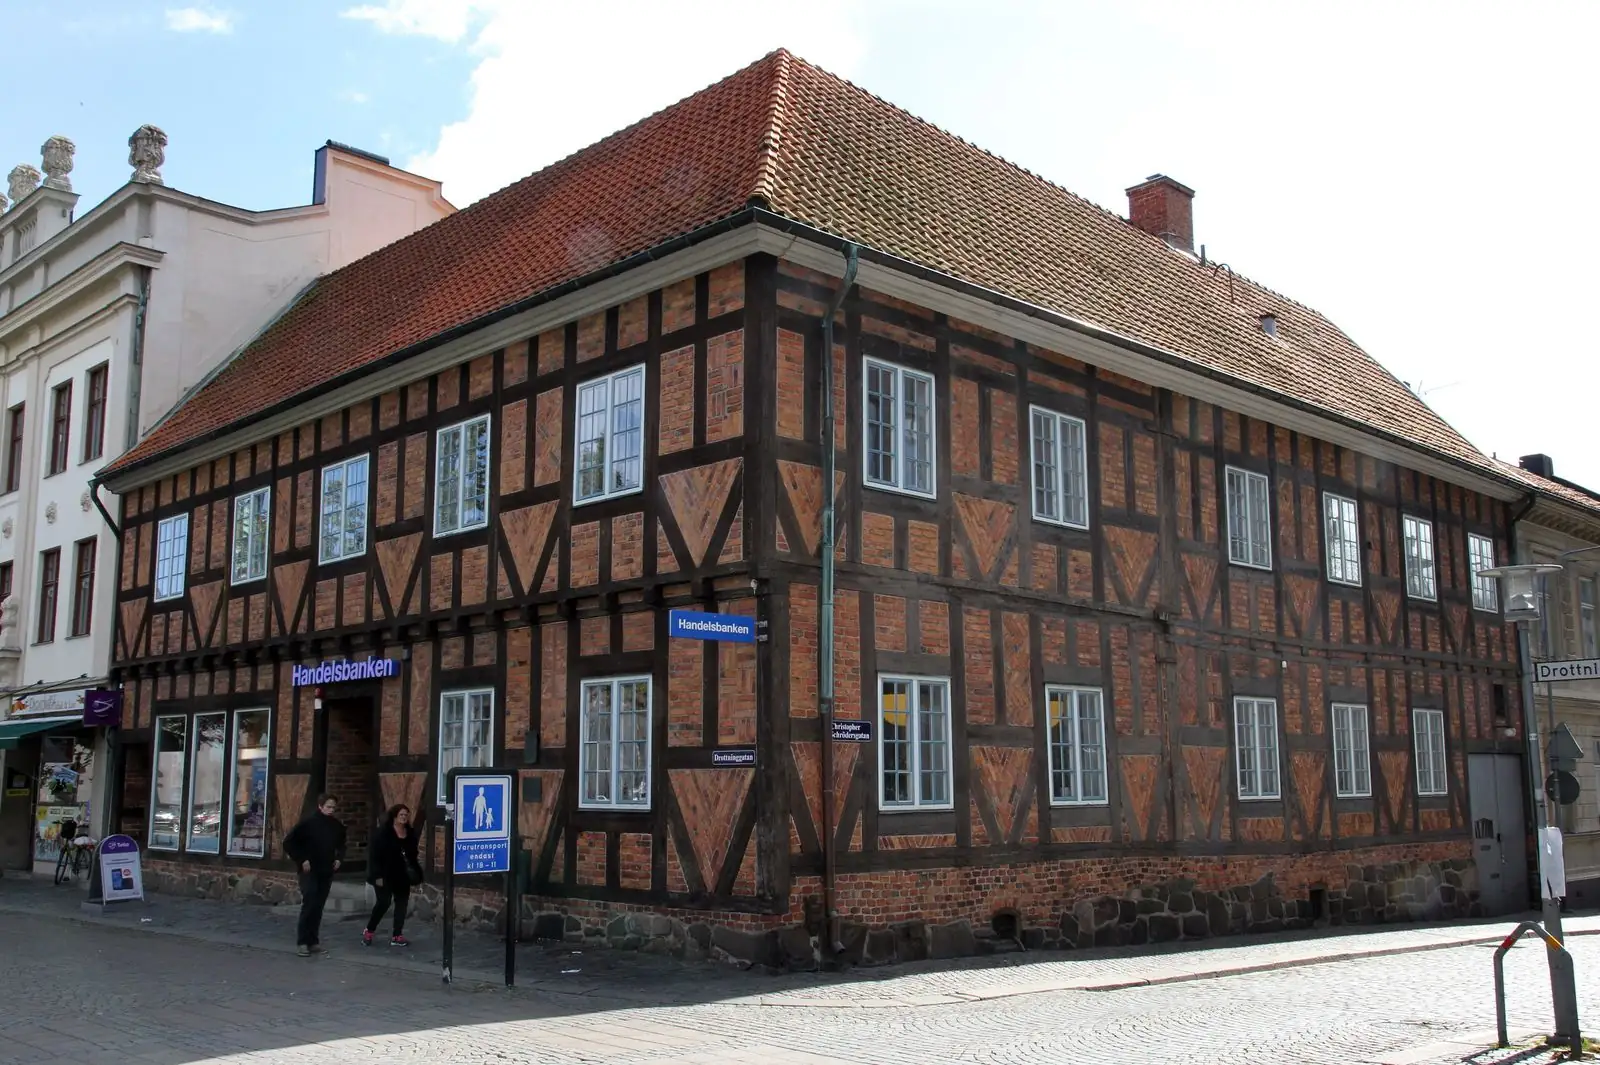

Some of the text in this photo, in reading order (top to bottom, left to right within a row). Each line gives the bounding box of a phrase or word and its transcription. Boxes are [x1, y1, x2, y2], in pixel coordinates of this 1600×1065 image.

[678, 618, 749, 635] Handelsbanken
[292, 655, 393, 687] Handelsbanken
[1540, 662, 1598, 678] Drottni
[457, 843, 507, 851] Varutransport
[470, 852, 494, 860] endast
